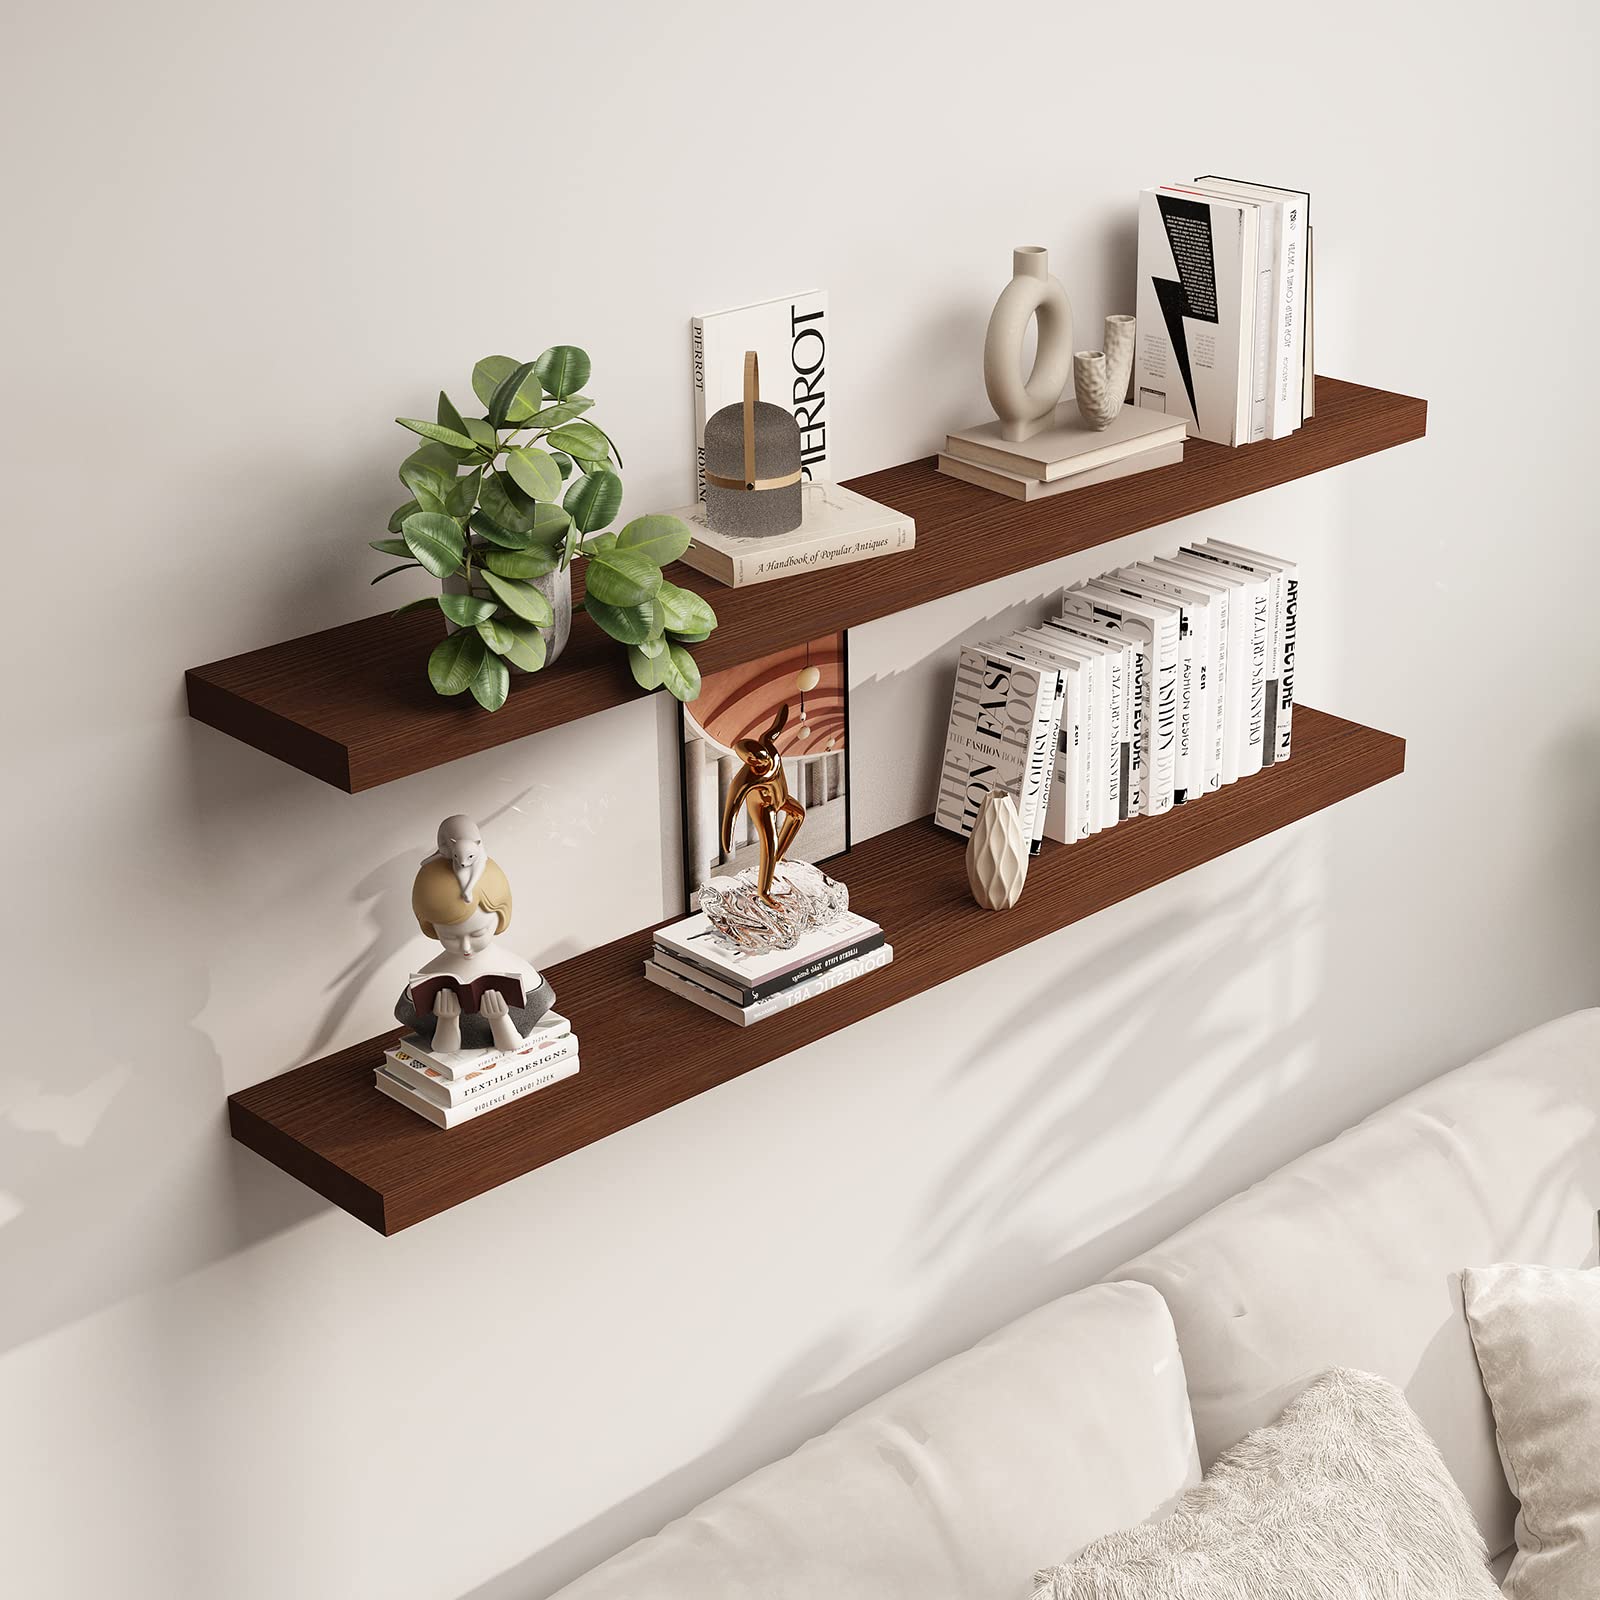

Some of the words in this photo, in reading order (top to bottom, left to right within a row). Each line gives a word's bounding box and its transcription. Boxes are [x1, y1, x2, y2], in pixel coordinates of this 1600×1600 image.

[694, 326, 704, 391] PIERROT
[755, 563, 764, 575] A
[766, 555, 809, 571] Handbook
[809, 550, 820, 564] of
[820, 544, 851, 561] Popular
[851, 538, 889, 554] Antiques
[1281, 579, 1298, 710] ARCHITECTURE
[1182, 657, 1192, 710] FASHION
[965, 738, 1000, 759] FASHION
[1181, 713, 1190, 756] DESIGN
[464, 1070, 514, 1097] TEXTILE
[516, 1047, 568, 1075] DESIGNS
[474, 1093, 506, 1112] VIOLENCE
